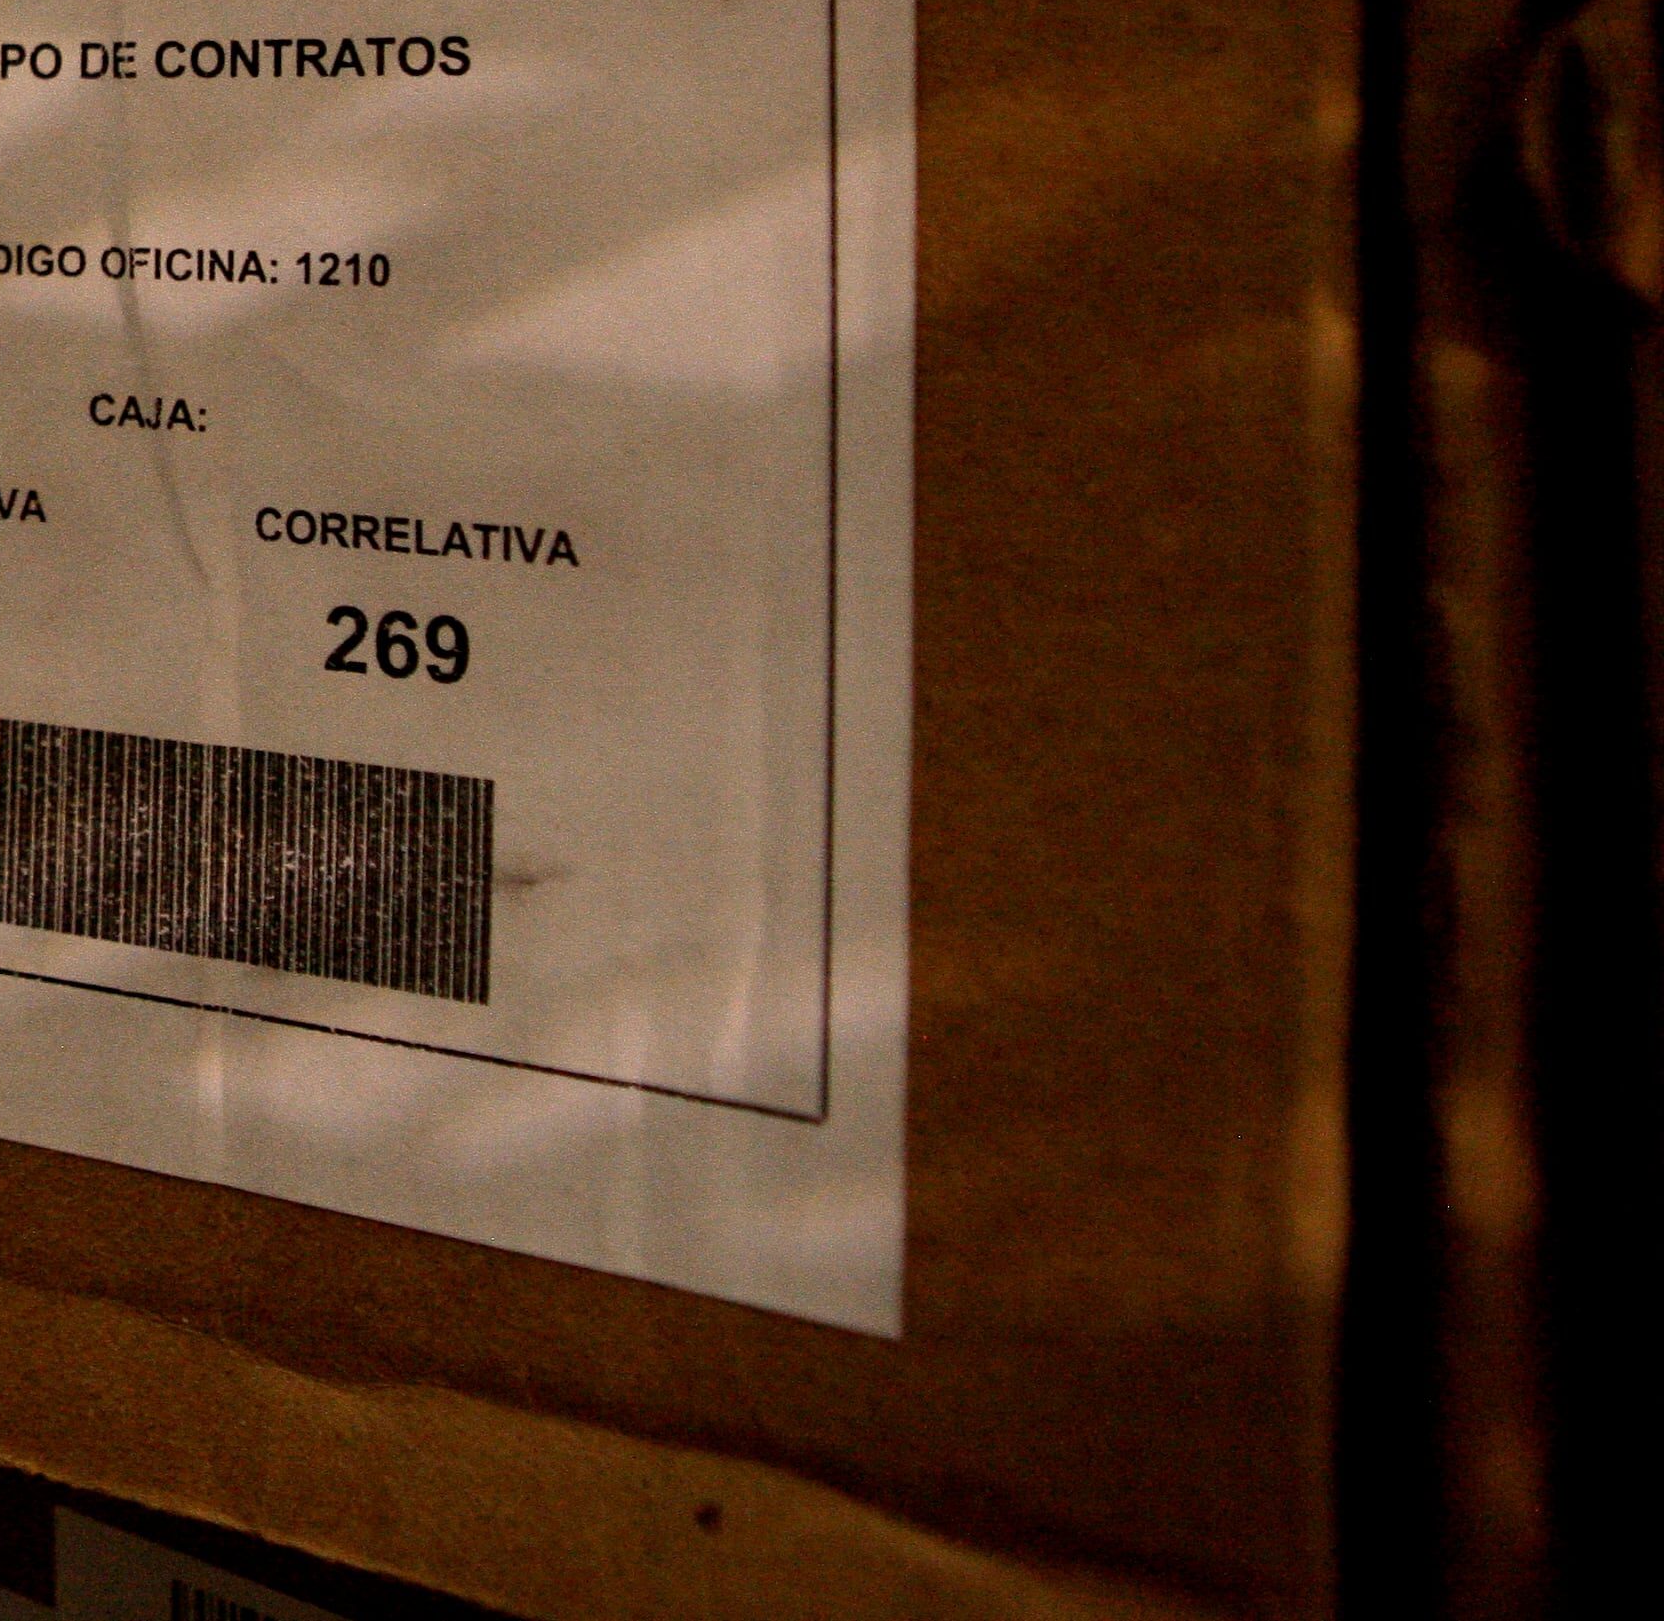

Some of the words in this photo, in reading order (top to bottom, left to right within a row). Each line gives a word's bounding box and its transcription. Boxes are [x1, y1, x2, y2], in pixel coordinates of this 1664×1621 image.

[80, 40, 137, 80] DE
[154, 35, 471, 79] CONTRATOS
[100, 244, 278, 285] OFICINA:
[297, 252, 392, 288] 1210
[88, 392, 206, 433] CAJA:
[255, 506, 580, 567] CORRELATIVA
[324, 605, 470, 685] 269
